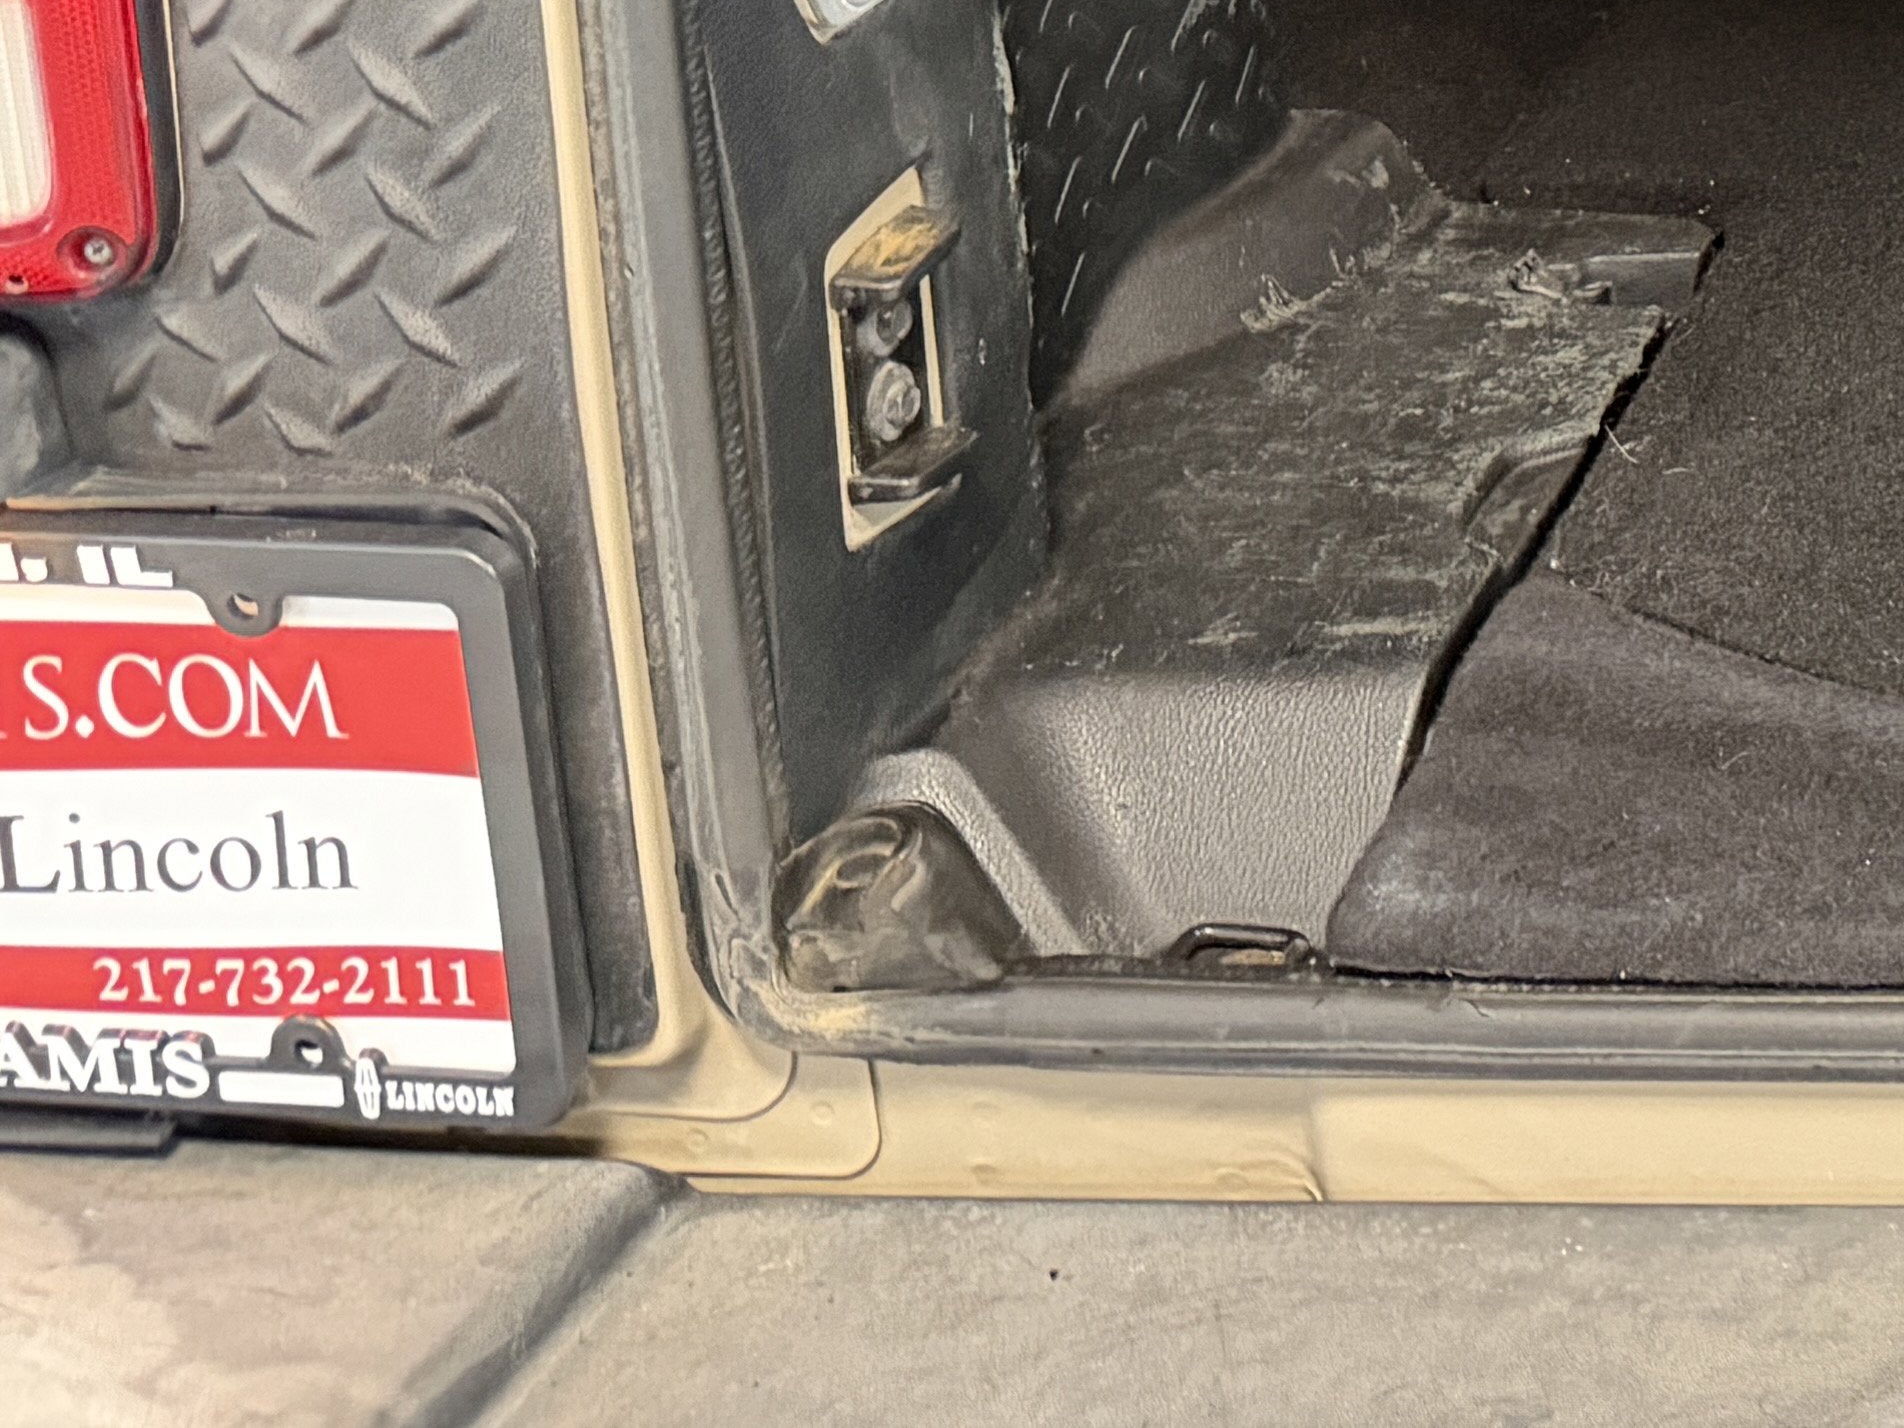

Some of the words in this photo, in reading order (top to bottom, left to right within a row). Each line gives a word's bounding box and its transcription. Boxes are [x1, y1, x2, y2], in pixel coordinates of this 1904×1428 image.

[77, 544, 173, 587] IL
[0, 652, 349, 741] S.COM
[0, 810, 358, 894] Lincoln
[93, 956, 476, 1007] 217-732-2111
[386, 1079, 515, 1118] LINCOLN
